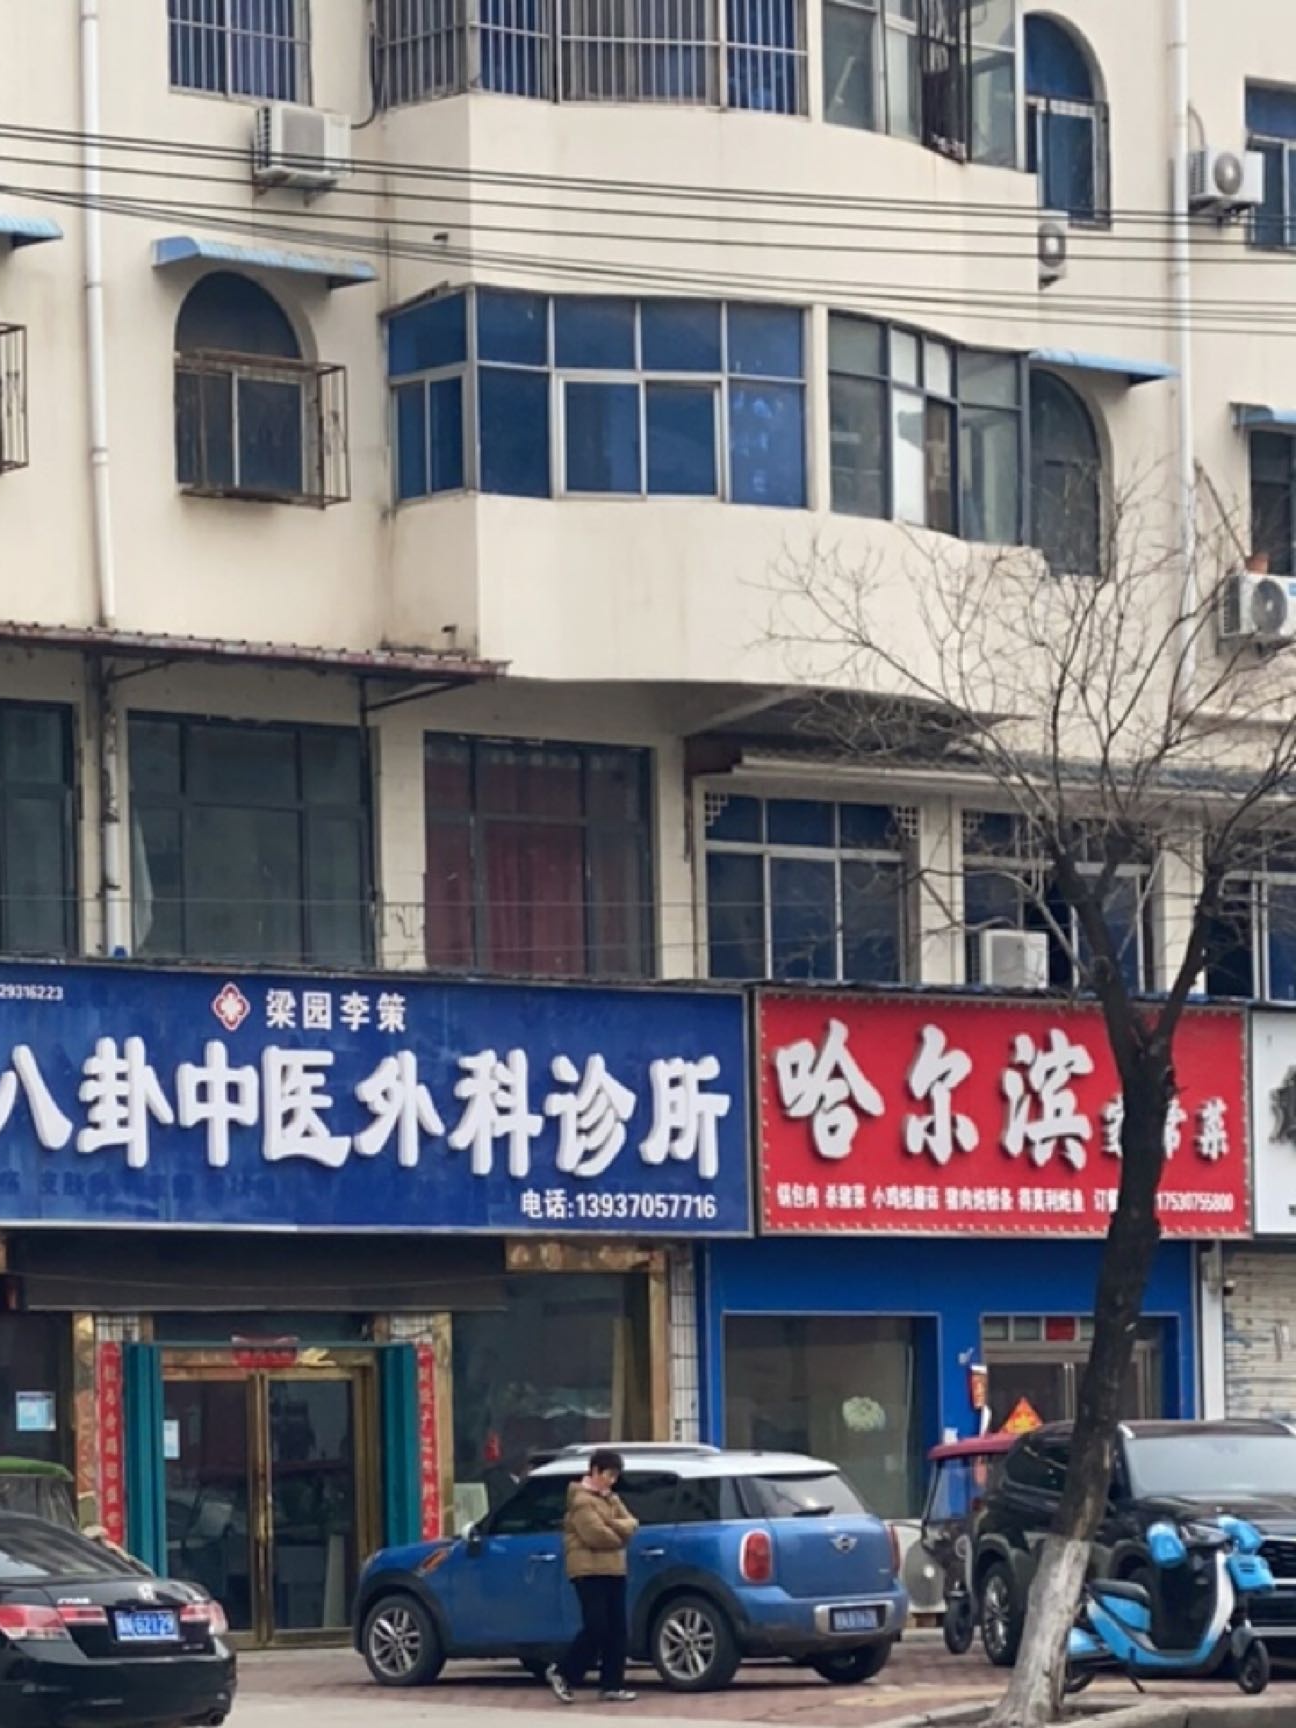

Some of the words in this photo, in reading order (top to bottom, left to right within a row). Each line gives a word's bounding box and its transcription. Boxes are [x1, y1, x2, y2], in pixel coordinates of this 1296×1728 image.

[266, 988, 406, 1033] 梁园李策
[774, 1018, 1095, 1169] 哈尔滨
[520, 1188, 717, 1219] 电话:13937057716
